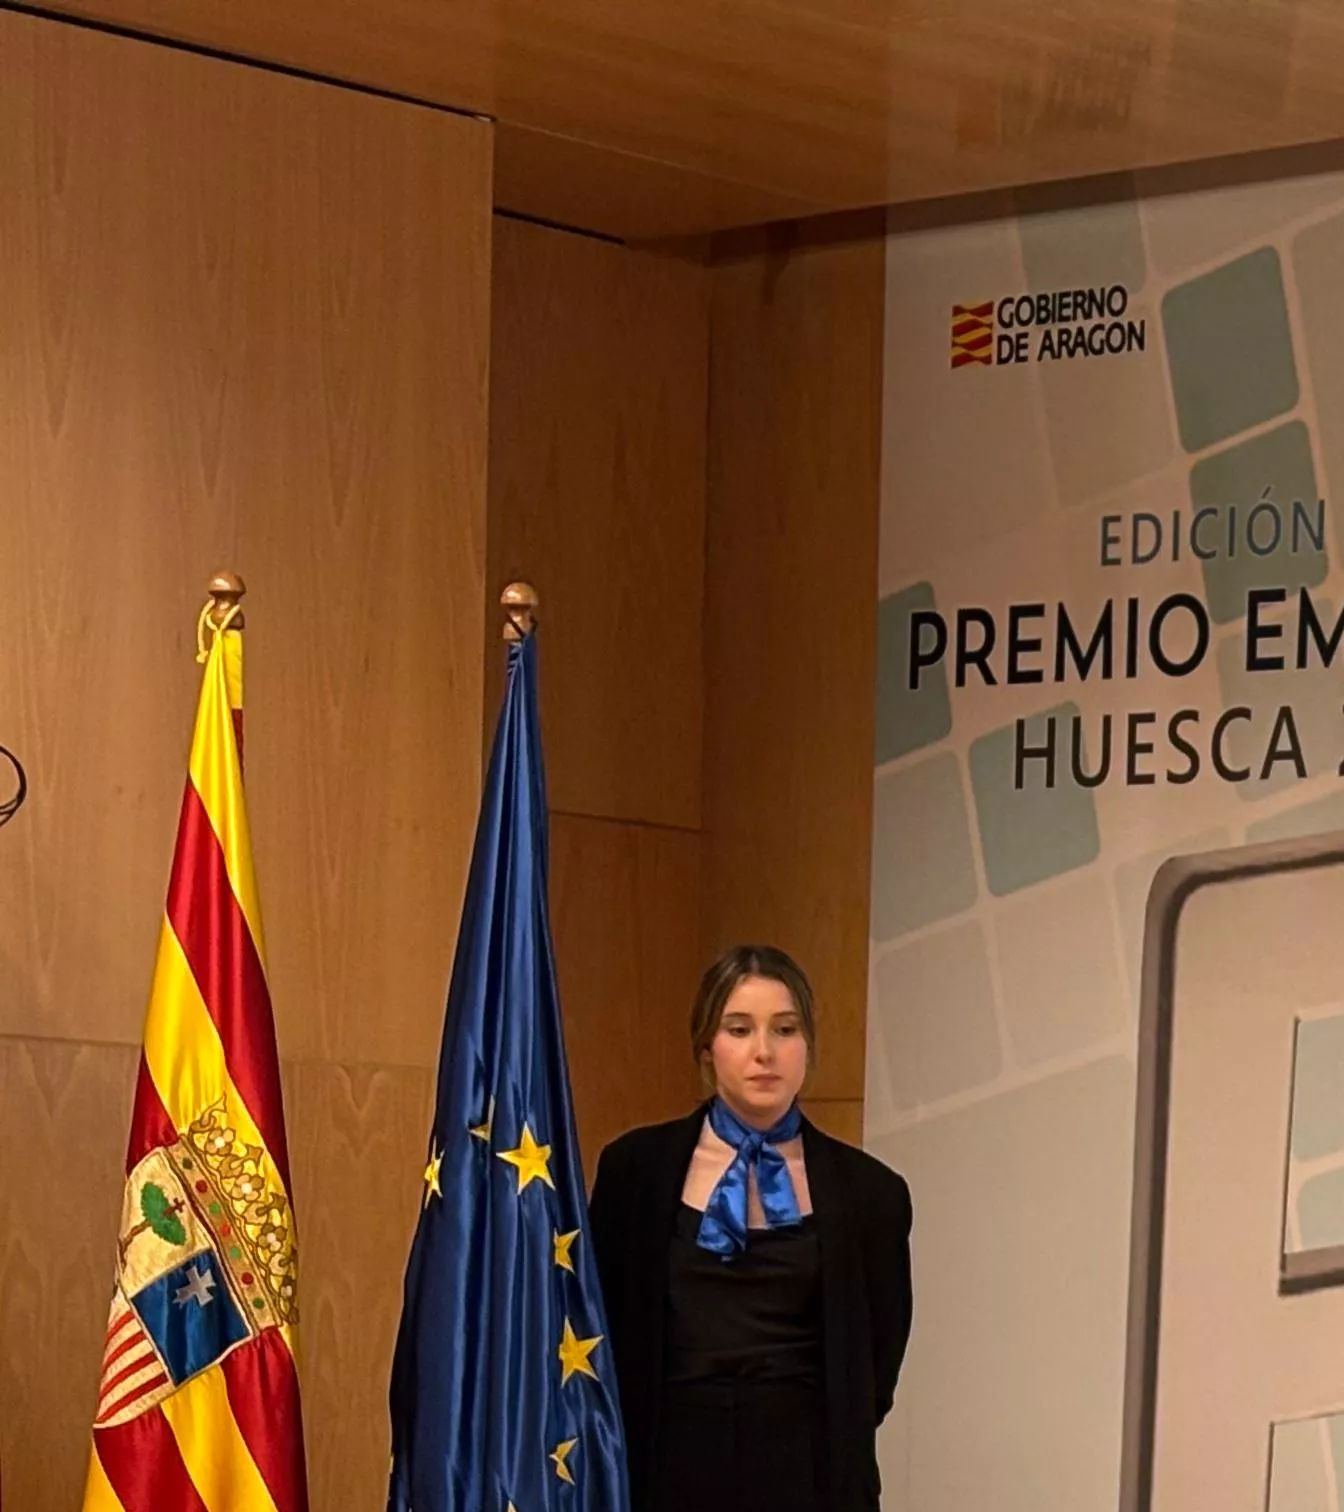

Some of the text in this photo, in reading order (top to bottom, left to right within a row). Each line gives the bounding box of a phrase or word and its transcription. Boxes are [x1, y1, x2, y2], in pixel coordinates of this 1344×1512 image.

[996, 320, 1145, 365] DE ARAGON
[997, 285, 1127, 329] GOBIERNO
[1100, 487, 1326, 566] EDICIÓN
[908, 593, 1211, 690] PREMIO
[1014, 704, 1309, 790] HUESCA
